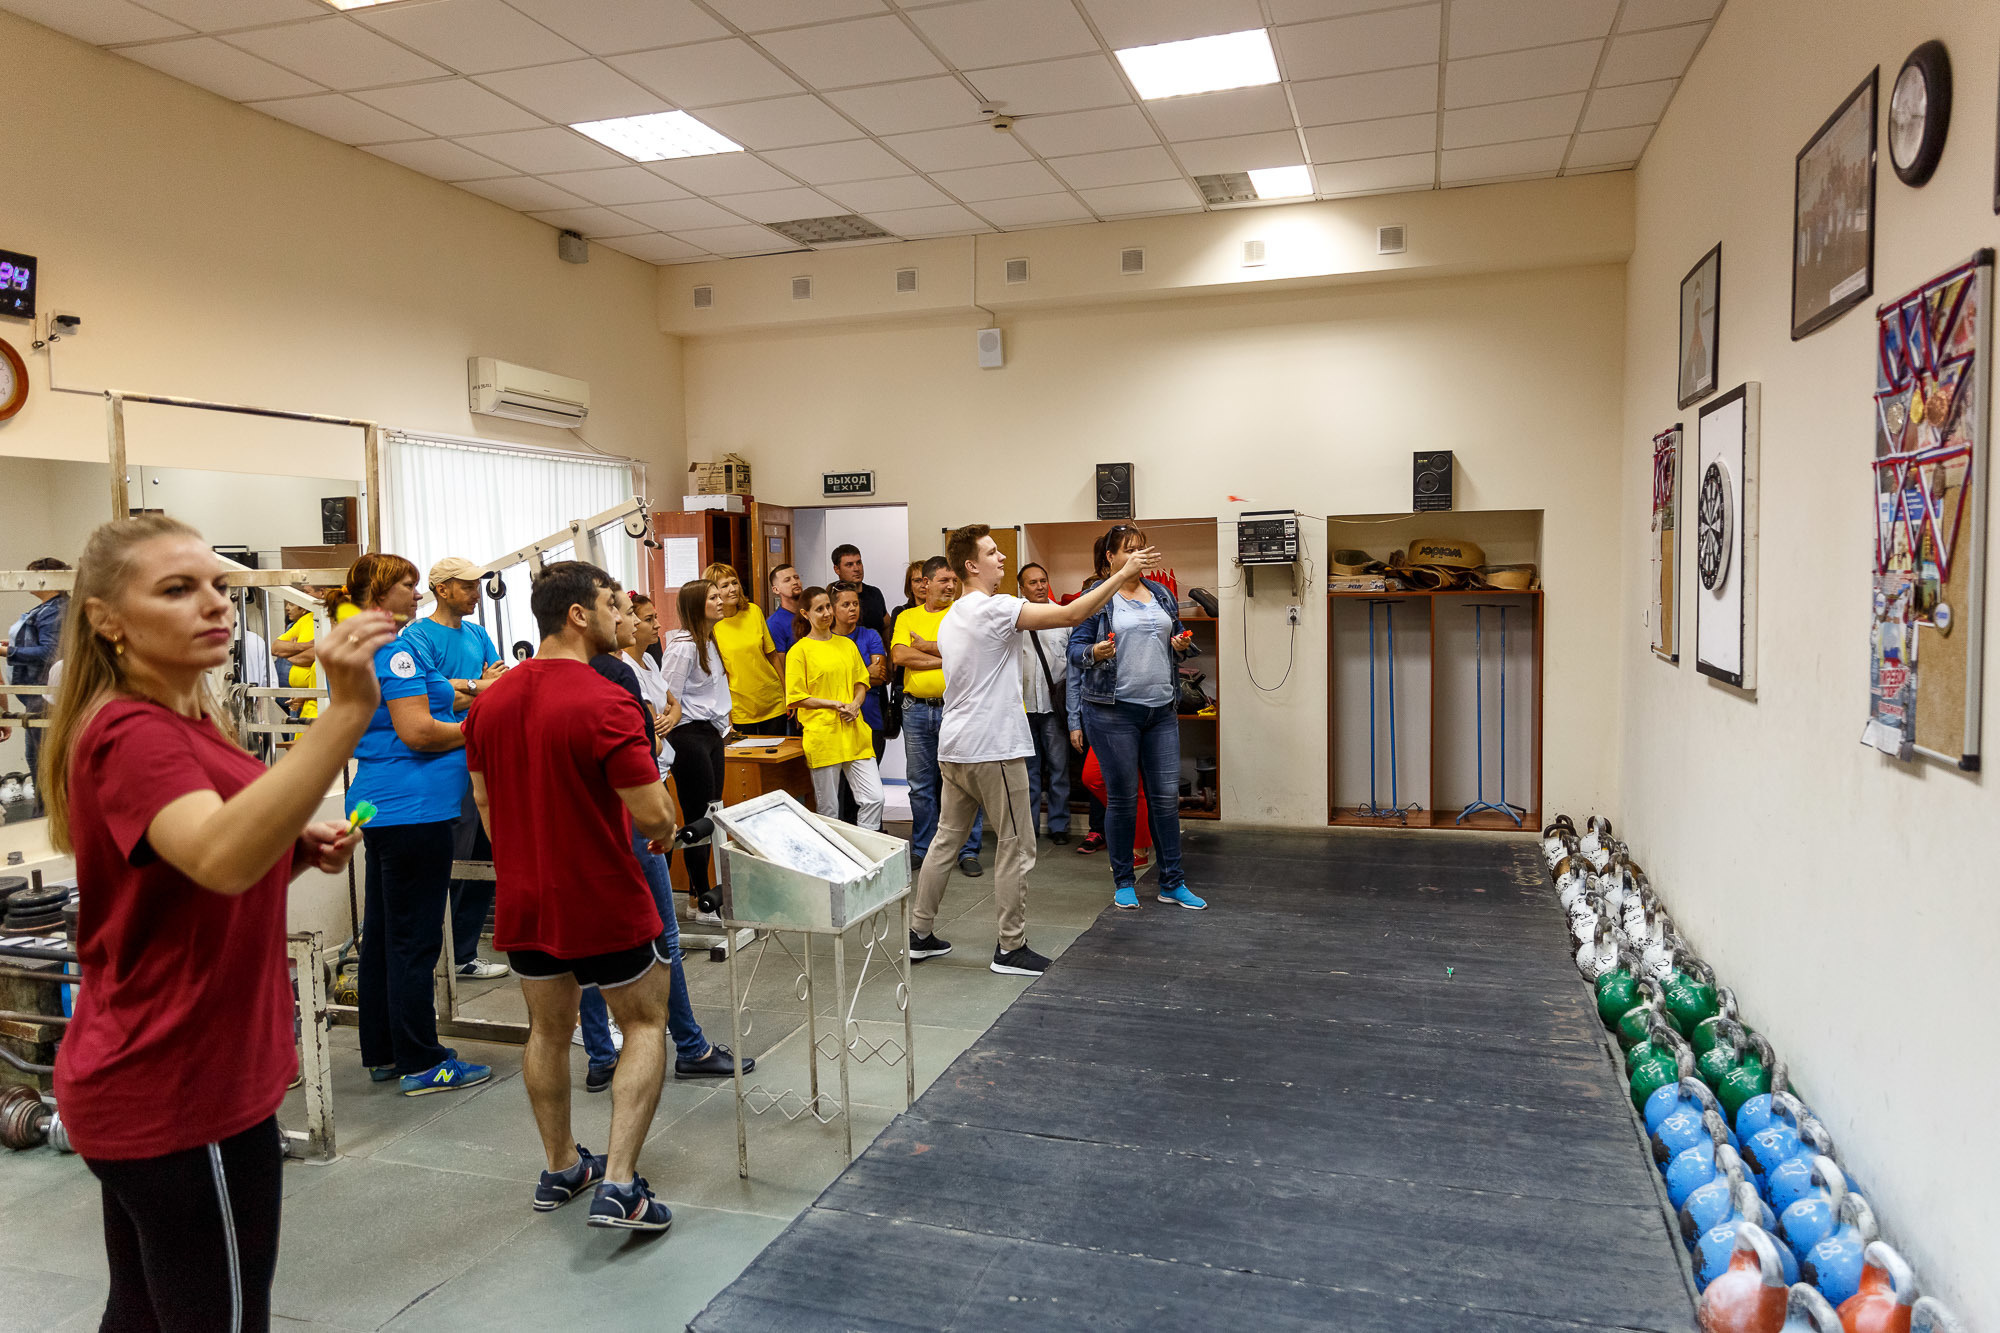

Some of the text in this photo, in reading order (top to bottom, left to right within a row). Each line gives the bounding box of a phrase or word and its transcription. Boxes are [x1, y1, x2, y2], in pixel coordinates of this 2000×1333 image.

[827, 475, 867, 485] ВЫХОД
[1668, 985, 1688, 1001] 24
[433, 1068, 454, 1082] N
[1640, 1058, 1662, 1078] 24
[1664, 1113, 1690, 1131] 26
[1753, 1127, 1783, 1148] 26
[1779, 1158, 1808, 1176] 27
[1709, 1223, 1735, 1244] 28
[1815, 1238, 1843, 1260] 28
